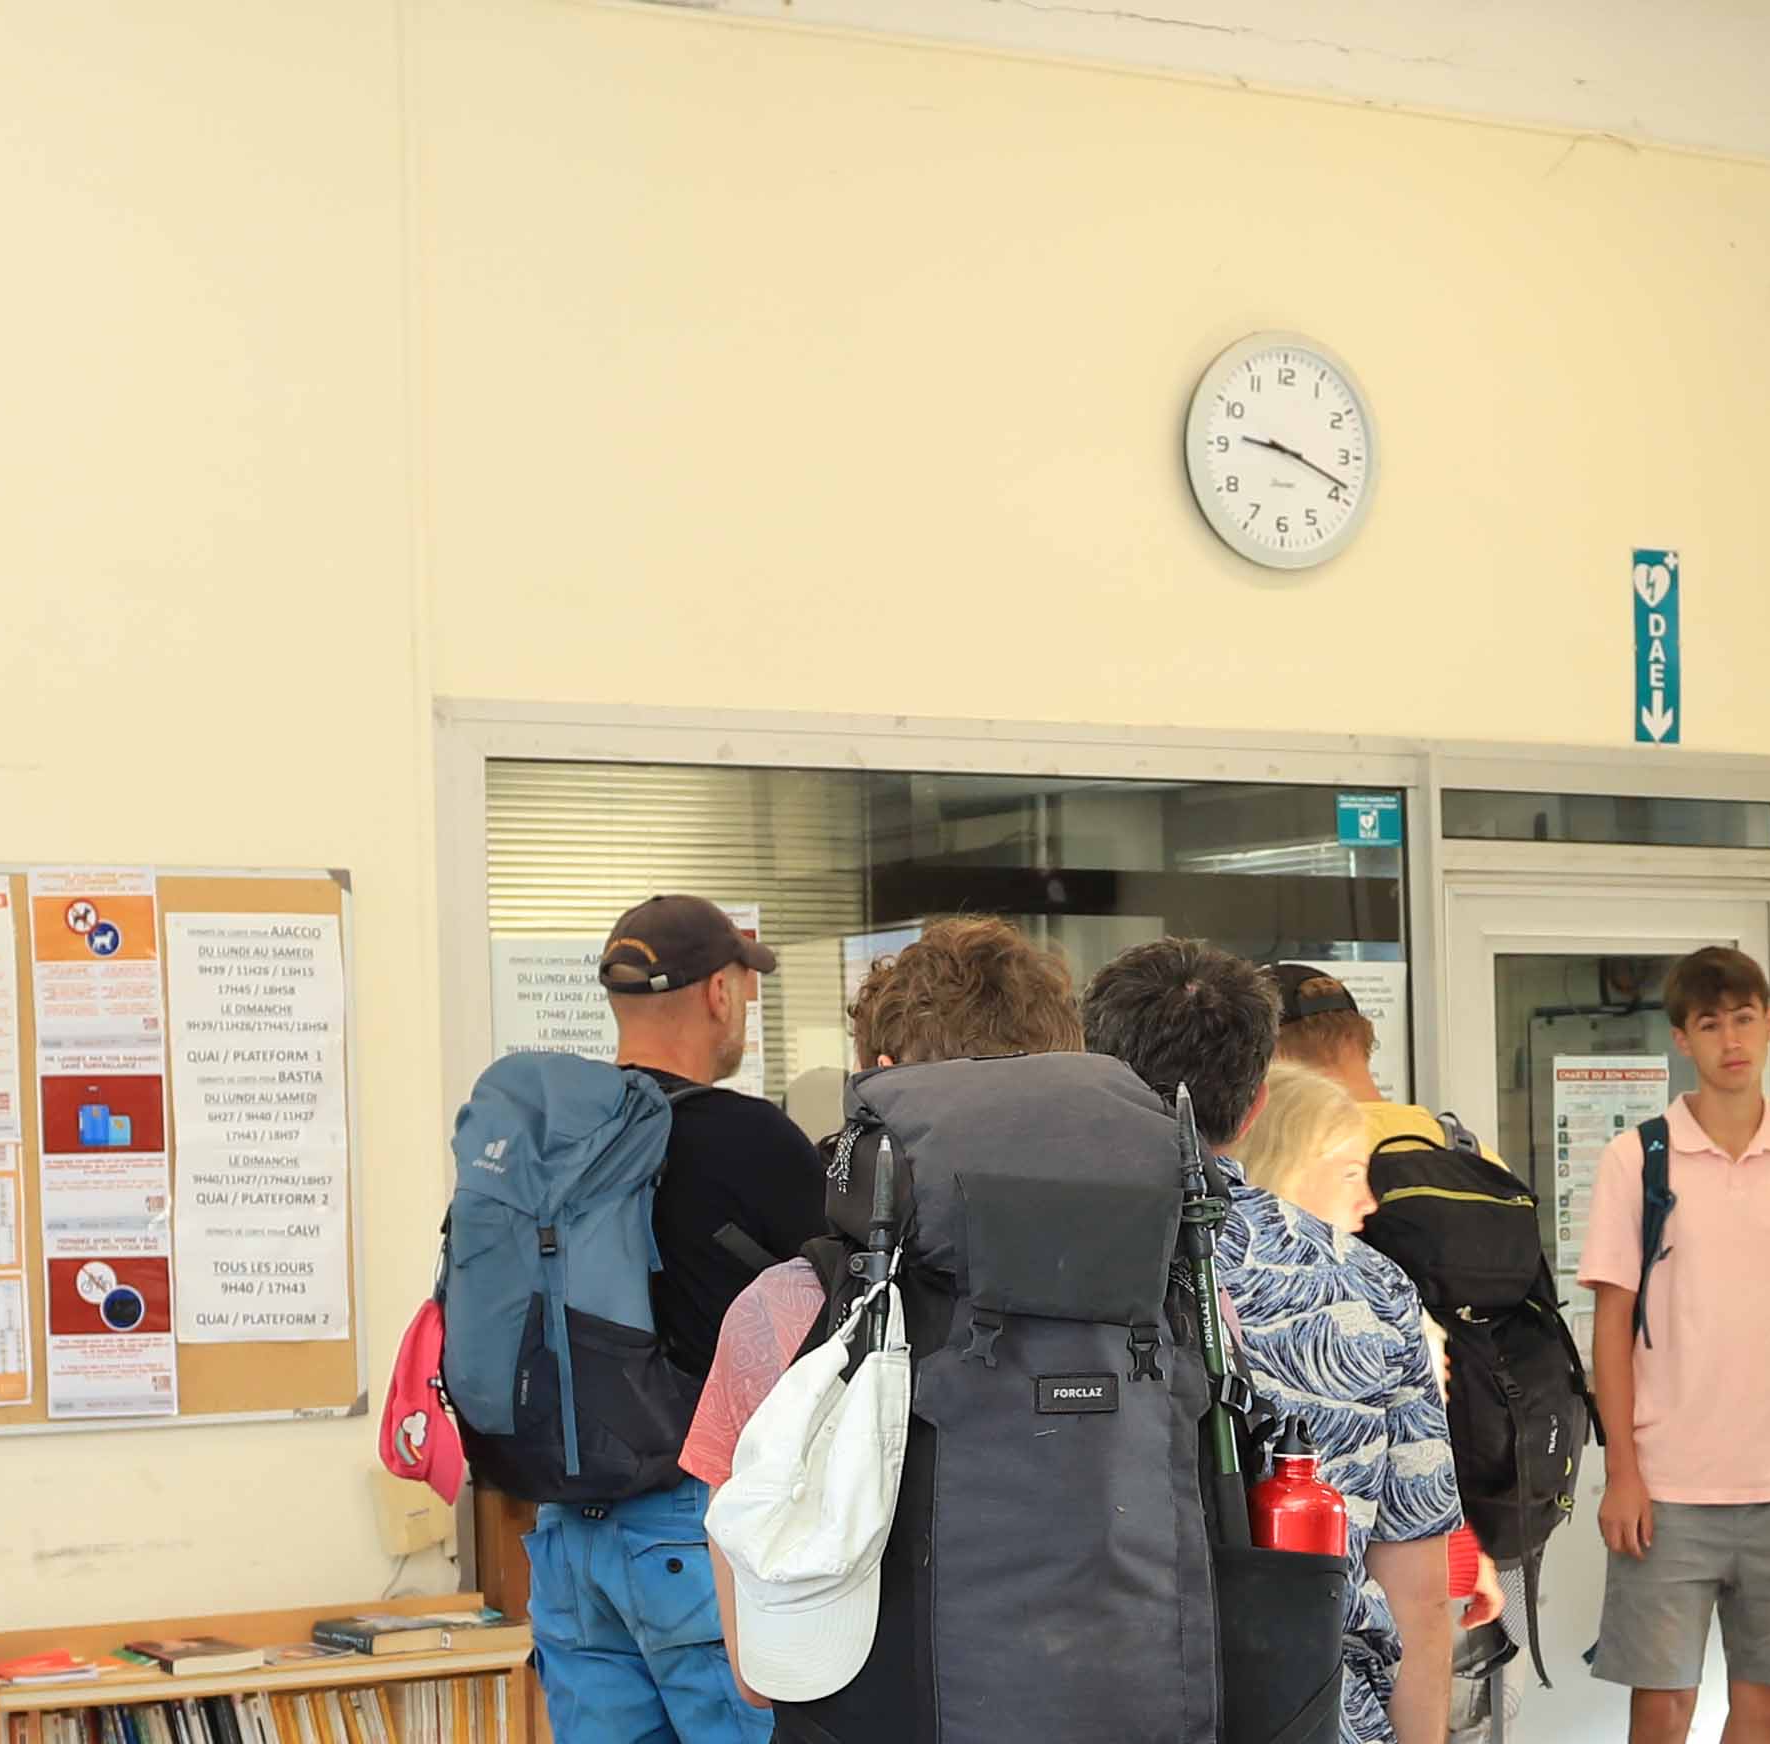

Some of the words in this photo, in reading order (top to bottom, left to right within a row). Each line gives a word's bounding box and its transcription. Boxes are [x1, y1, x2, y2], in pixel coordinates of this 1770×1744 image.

[1249, 375, 1262, 393] 11
[1278, 368, 1297, 387] 12
[1313, 381, 1321, 399] 1
[1225, 401, 1245, 419] 10
[1329, 411, 1344, 430] 2
[1215, 435, 1231, 453] 9
[1337, 448, 1351, 466] 3
[1225, 475, 1240, 493] 8
[1326, 485, 1341, 502] 4
[1247, 502, 1262, 520] 7
[1304, 509, 1318, 527] 5
[1275, 516, 1289, 533] 6
[1647, 612, 1666, 688] DAE
[198, 945, 214, 958] DU
[217, 945, 251, 958] LUNDI
[252, 946, 269, 958] AU
[272, 946, 315, 959] SAMEDI
[220, 1004, 233, 1015] LE
[235, 1004, 294, 1017] DIMANCHE
[187, 1050, 220, 1064] QUAI
[233, 1050, 309, 1063] PLATEFORM
[278, 1070, 323, 1084] BASTIA
[204, 1092, 220, 1105] DU
[222, 1092, 256, 1105] LUNDI
[257, 1093, 274, 1105] AU
[276, 1092, 318, 1105] SAMEDI
[228, 1156, 241, 1167] LE
[242, 1156, 300, 1167] DIMANCHE
[196, 1192, 229, 1206] QUAI
[241, 1192, 316, 1205] PLATEFORM
[321, 1193, 329, 1206] 2
[286, 1223, 321, 1238] CALVI
[212, 1261, 248, 1274] TOUS
[250, 1261, 272, 1274] LES
[274, 1261, 315, 1274] JOURS
[221, 1282, 255, 1294] 9H40
[267, 1282, 307, 1294] 17H43
[196, 1312, 229, 1326] QUAI
[242, 1312, 317, 1325] PLATEFORM
[322, 1312, 330, 1325] 2
[1200, 1301, 1214, 1349] FORCLAZ
[1053, 1387, 1103, 1399] FORCLAZ
